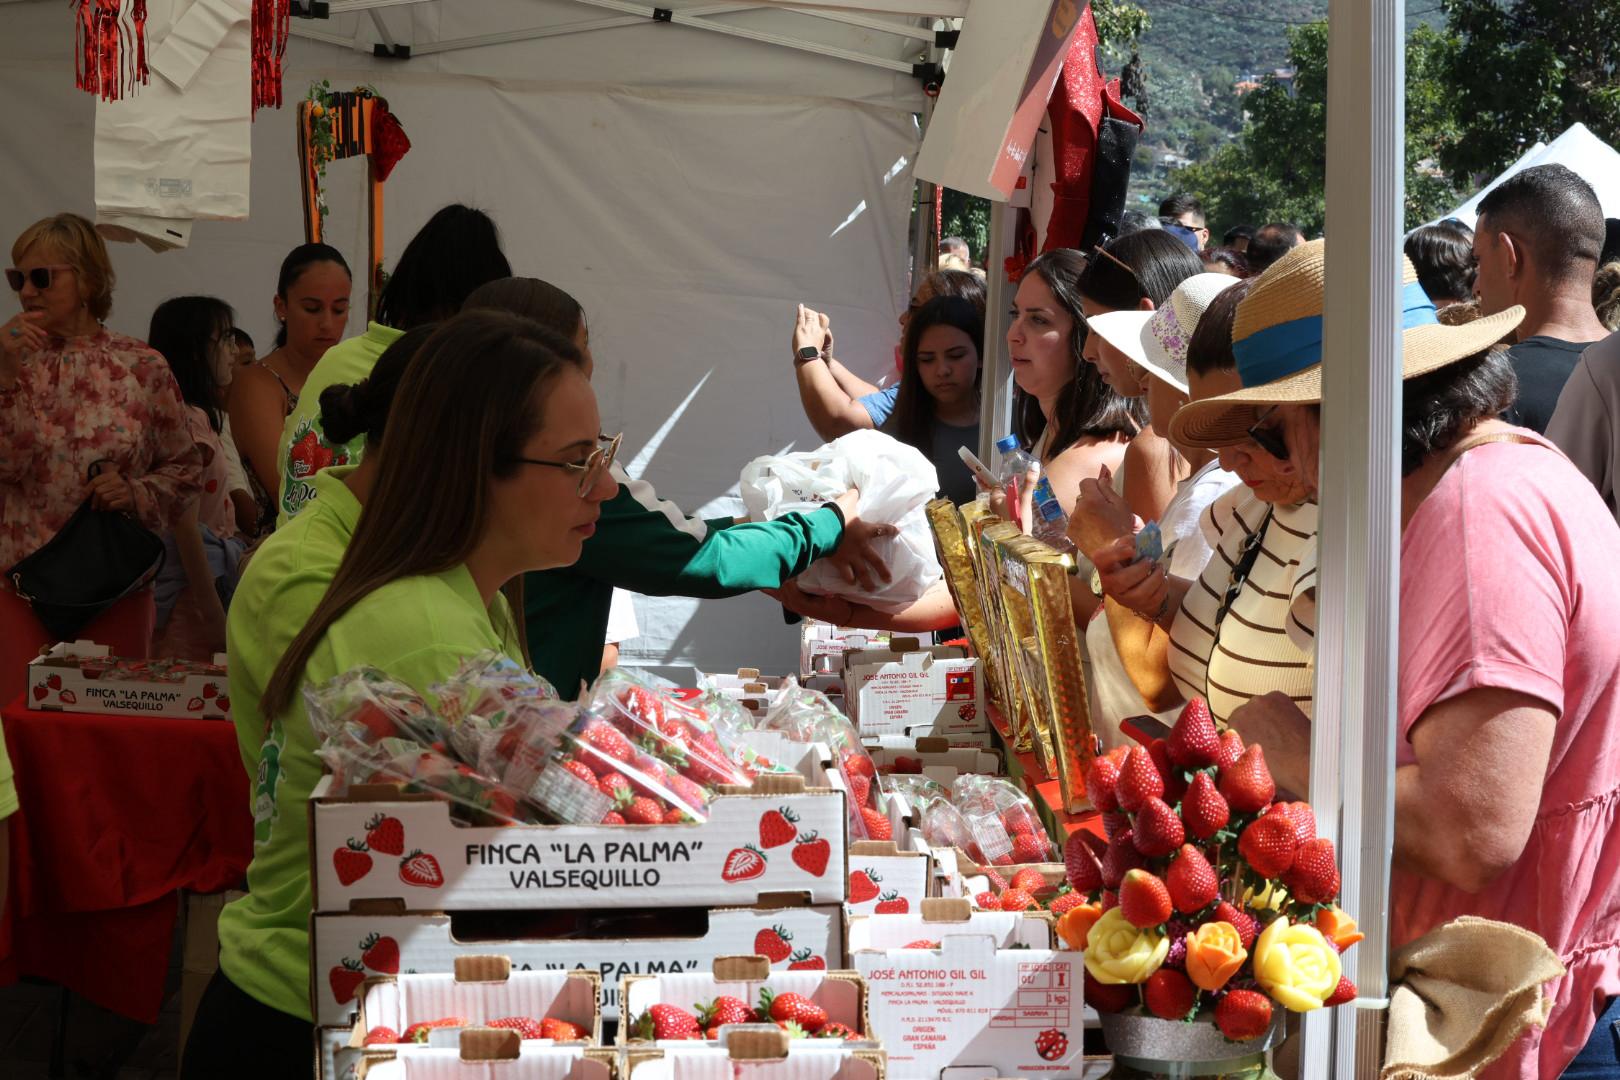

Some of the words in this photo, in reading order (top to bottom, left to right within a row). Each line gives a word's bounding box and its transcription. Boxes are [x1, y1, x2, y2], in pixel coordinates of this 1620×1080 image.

[86, 688, 116, 698] FINCA
[120, 689, 139, 700] "LA
[141, 691, 181, 702] PALMA"
[103, 700, 163, 711] VALSEQUILLO
[465, 843, 541, 865] FINCA
[551, 842, 595, 864] "LA
[604, 841, 703, 863] PALMA"
[510, 868, 660, 890] VALSEQUILLO
[868, 968, 895, 980] JOSÉ
[898, 969, 947, 979] ANTONIO
[950, 969, 967, 979] GIL
[969, 969, 987, 979] GIL
